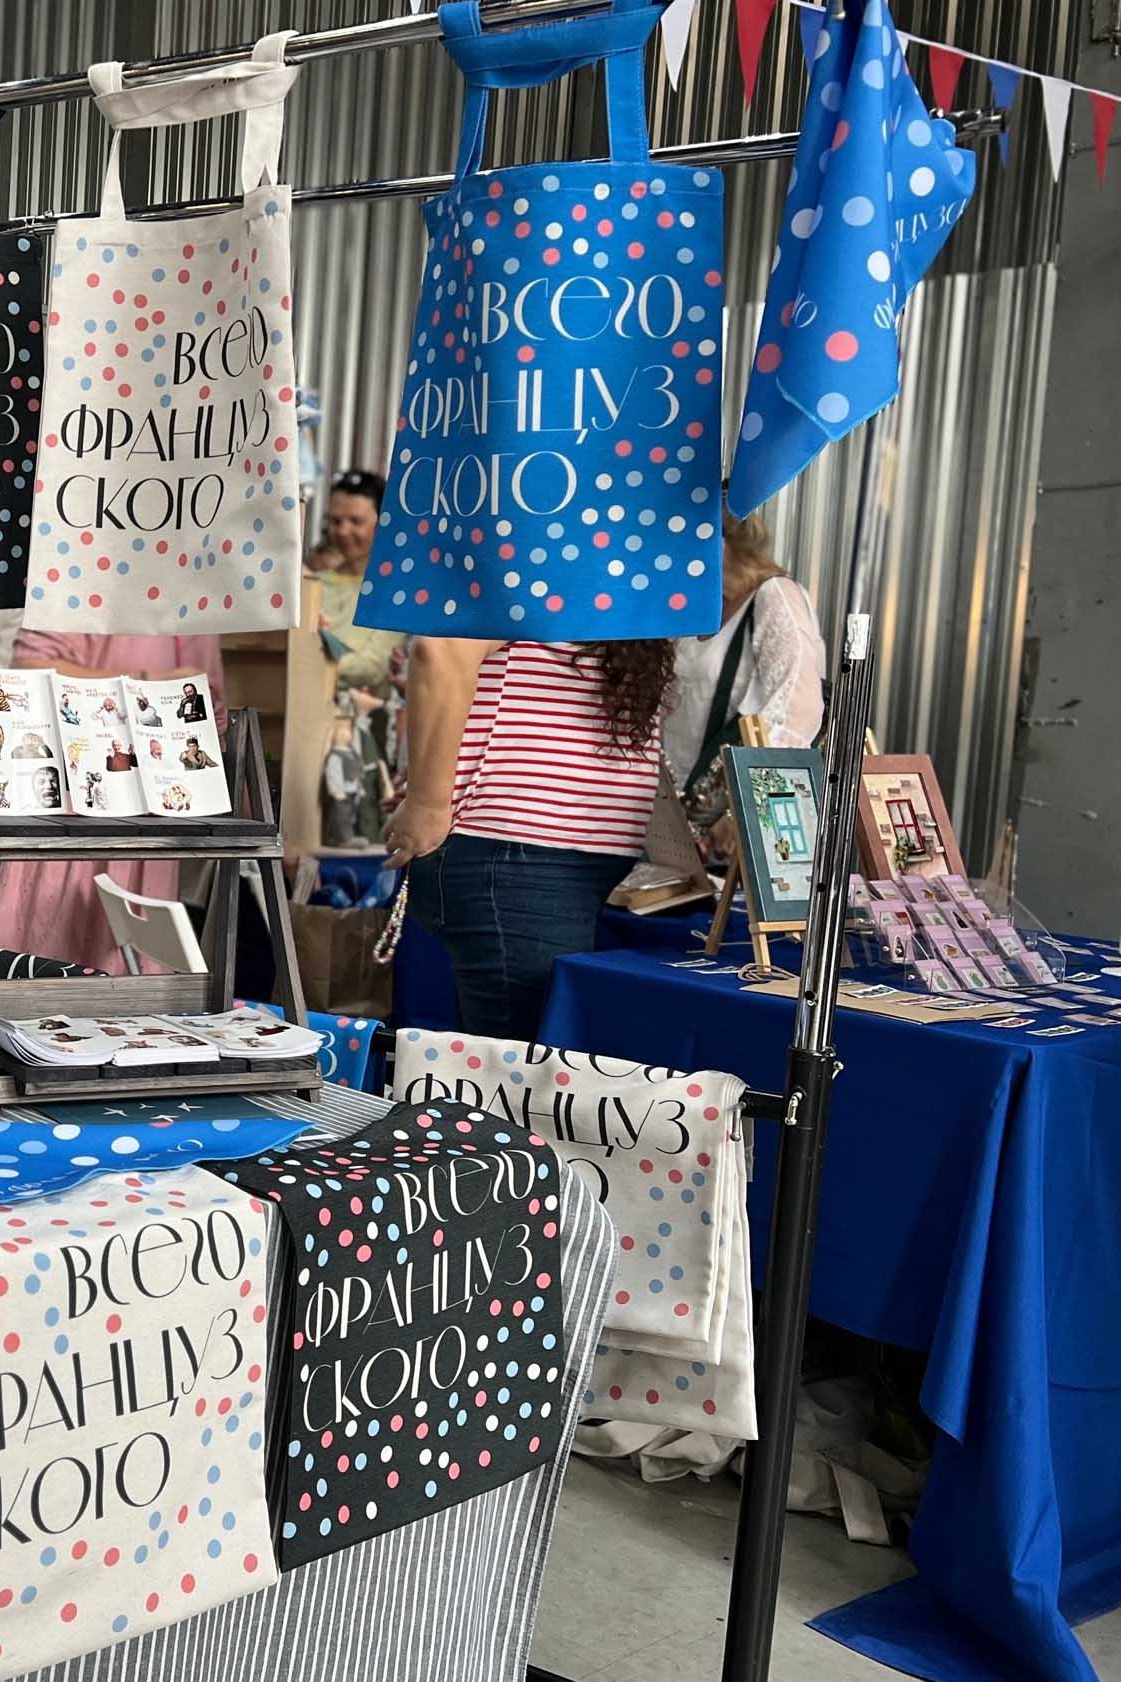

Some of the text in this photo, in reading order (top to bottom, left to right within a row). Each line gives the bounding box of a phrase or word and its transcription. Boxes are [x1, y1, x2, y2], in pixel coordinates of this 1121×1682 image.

[60, 388, 270, 467] ФРАНЦУЗ
[408, 364, 681, 446] ФРАНЦУЗ
[56, 474, 225, 531] СКОГО
[399, 450, 579, 517] СКОГО
[304, 1223, 534, 1348] ФРАНЦУЗ
[303, 1325, 466, 1432] СКОГО
